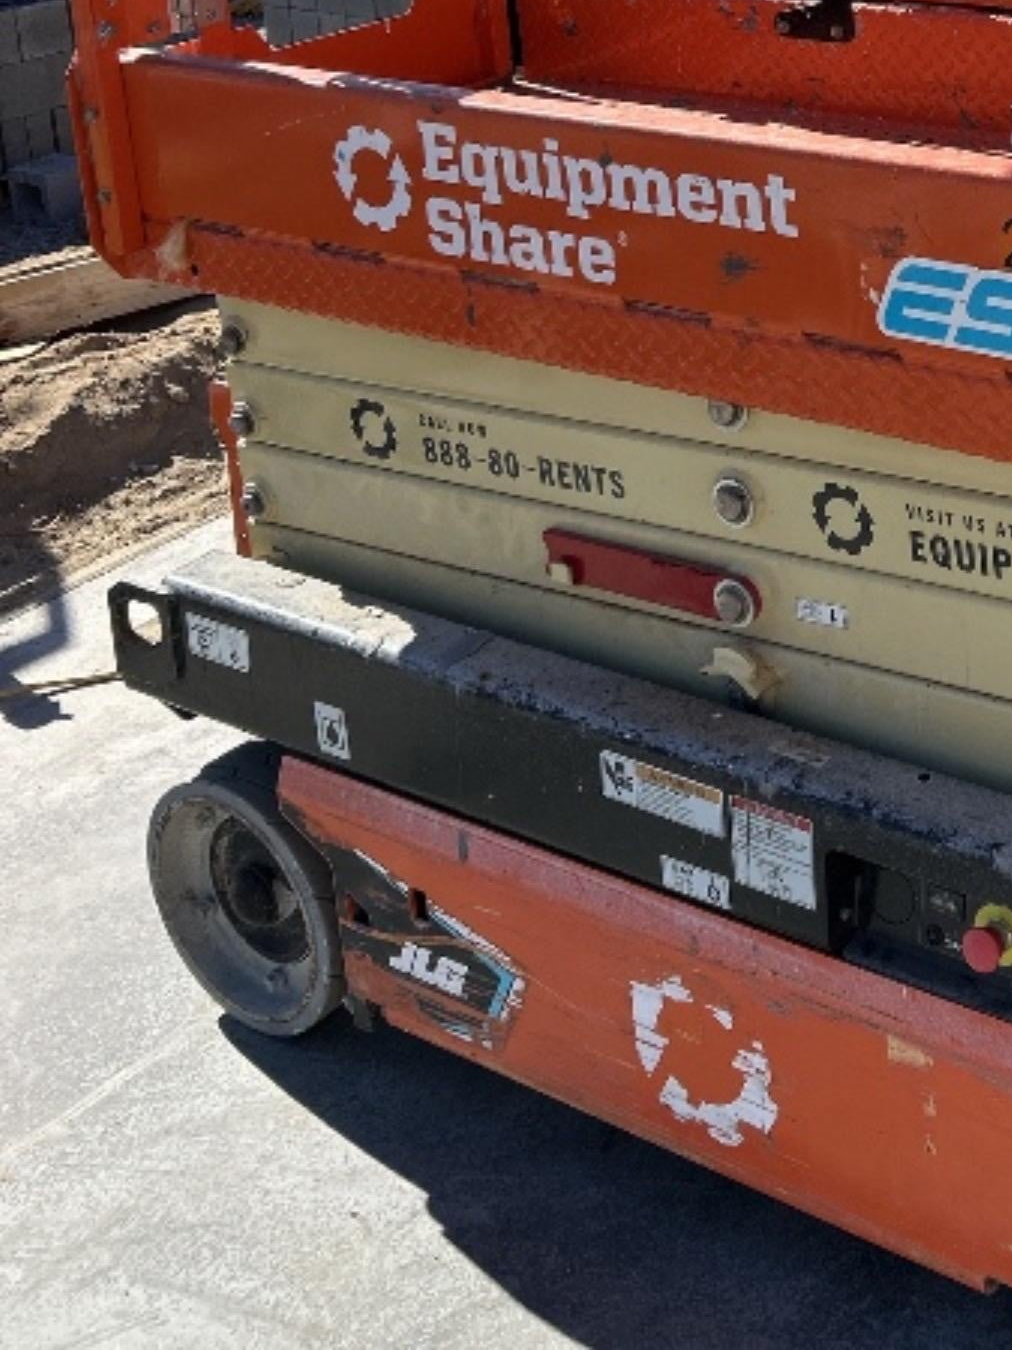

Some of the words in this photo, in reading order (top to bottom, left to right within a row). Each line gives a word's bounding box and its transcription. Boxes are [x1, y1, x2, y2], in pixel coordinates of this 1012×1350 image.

[417, 119, 799, 238] Equipment
[422, 436, 626, 500] 888-80-RENTS
[904, 502, 954, 527] VISIT
[962, 514, 985, 534] US
